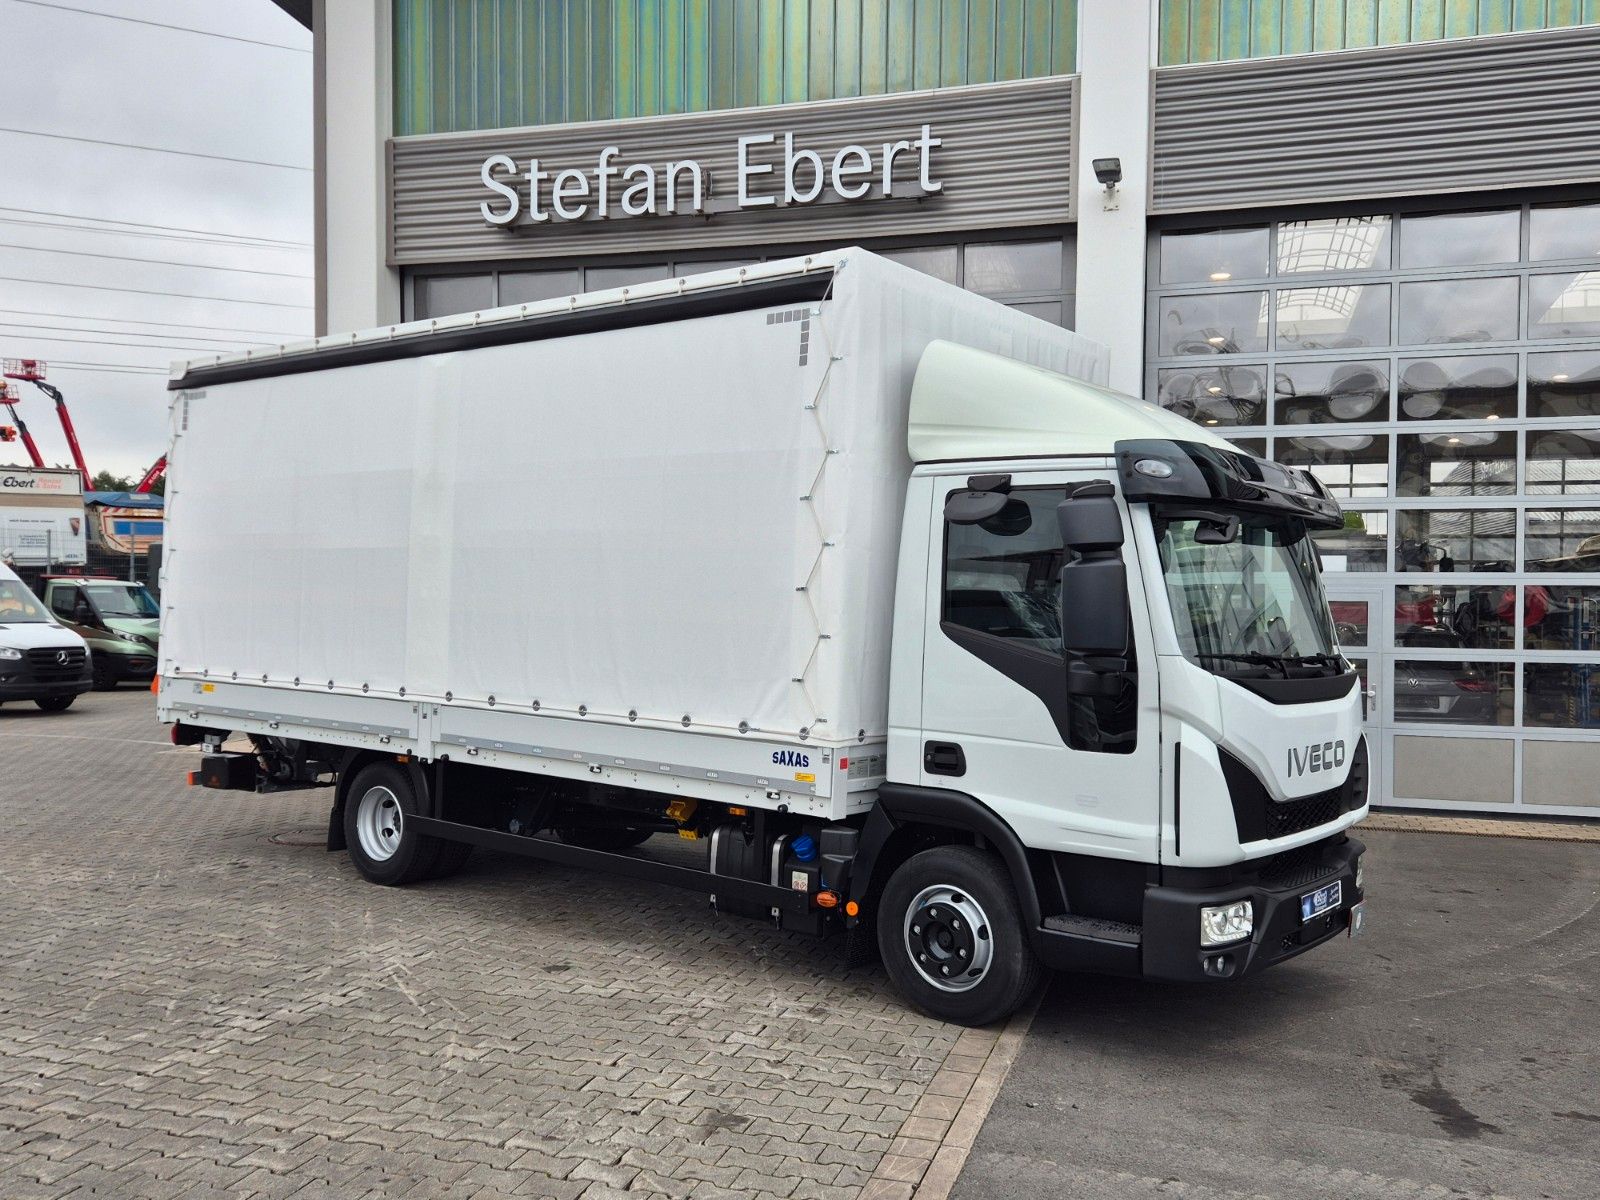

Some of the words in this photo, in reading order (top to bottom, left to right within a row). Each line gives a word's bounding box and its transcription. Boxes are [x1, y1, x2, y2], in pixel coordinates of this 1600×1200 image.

[480, 146, 702, 225] Stefan
[737, 124, 943, 207] Ebert
[3, 476, 35, 488] Ebert
[772, 750, 810, 768] SAXAS
[1287, 739, 1345, 778] IVECO
